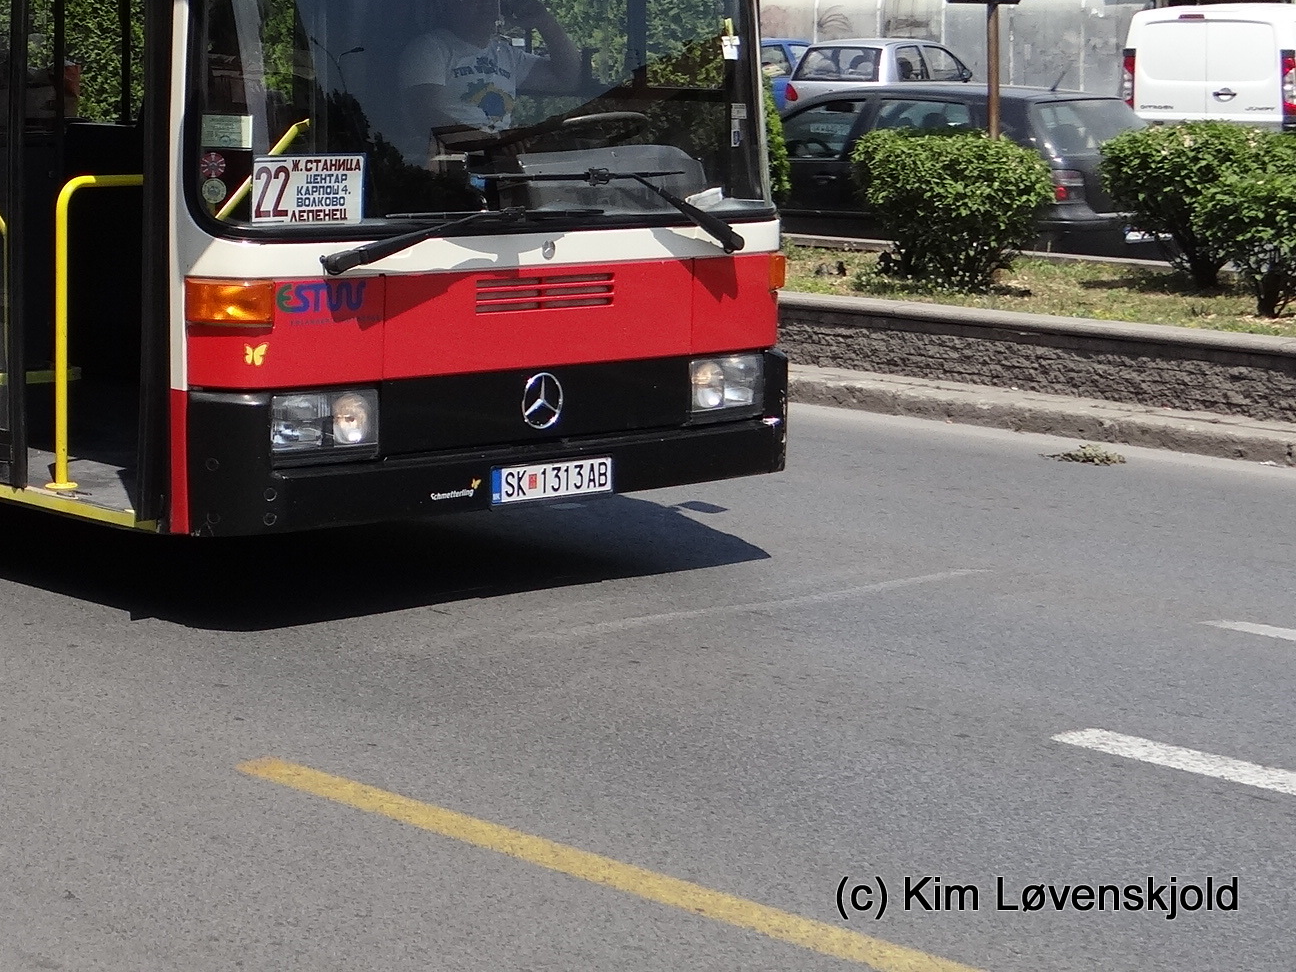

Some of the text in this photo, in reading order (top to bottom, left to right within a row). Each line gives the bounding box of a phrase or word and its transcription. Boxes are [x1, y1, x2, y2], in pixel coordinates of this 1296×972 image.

[306, 173, 348, 185] ЦЕНТАР
[254, 165, 291, 219] 22
[296, 185, 340, 197] КАРПОШ
[296, 196, 346, 208] ВОЛКОВО
[290, 208, 348, 223] ЛЕПЕНЕЦ
[504, 470, 527, 498] SK
[540, 461, 609, 494] 1313AB
